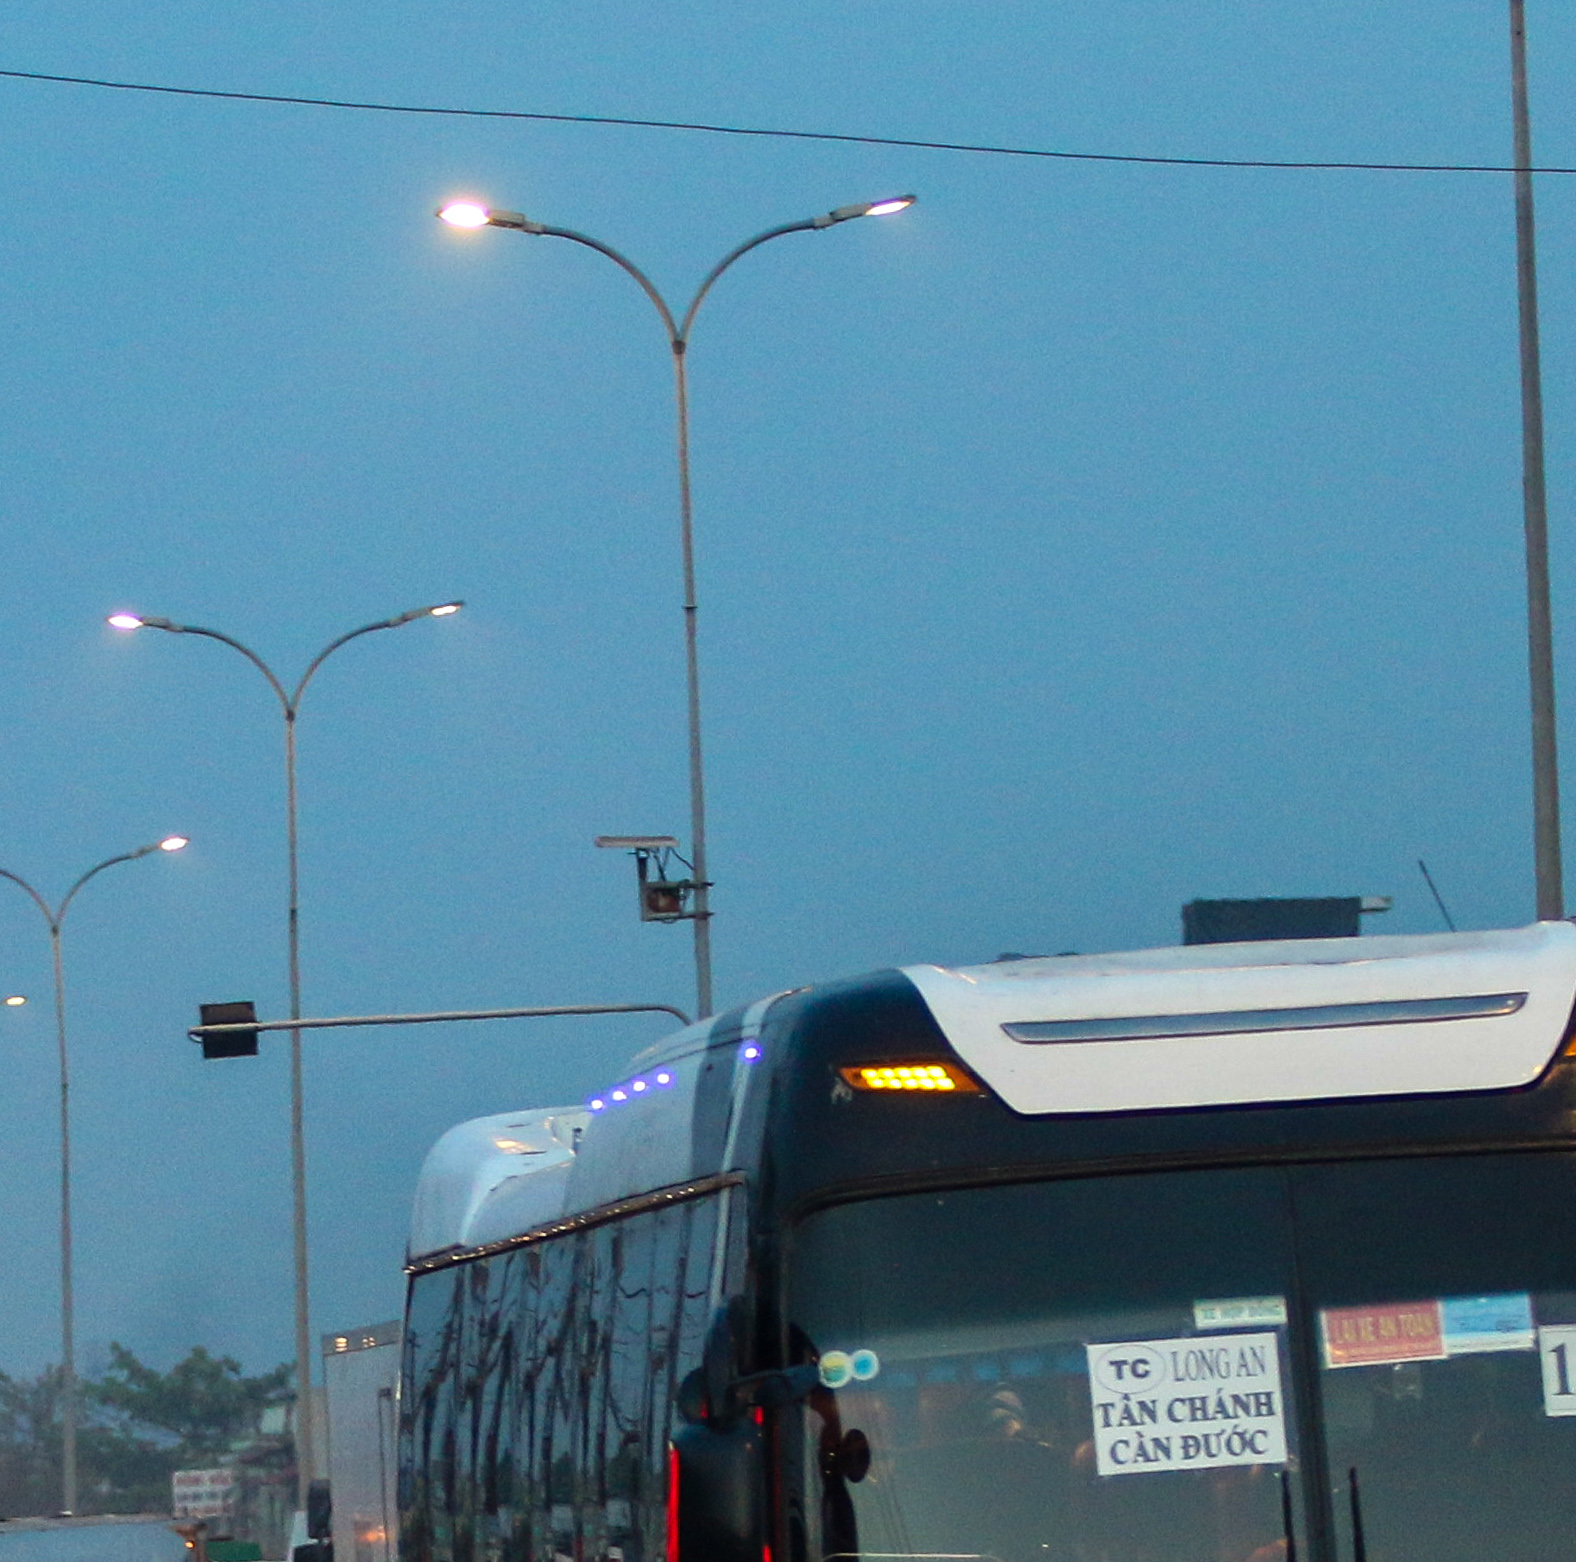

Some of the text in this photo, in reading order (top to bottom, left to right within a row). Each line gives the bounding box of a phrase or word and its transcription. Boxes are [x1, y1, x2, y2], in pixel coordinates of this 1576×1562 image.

[1109, 1358, 1151, 1380] TC
[1171, 1345, 1266, 1382] LONG AN
[1098, 1388, 1276, 1428] TÂN CHÁNH
[1181, 1424, 1268, 1460] ĐƯỚC
